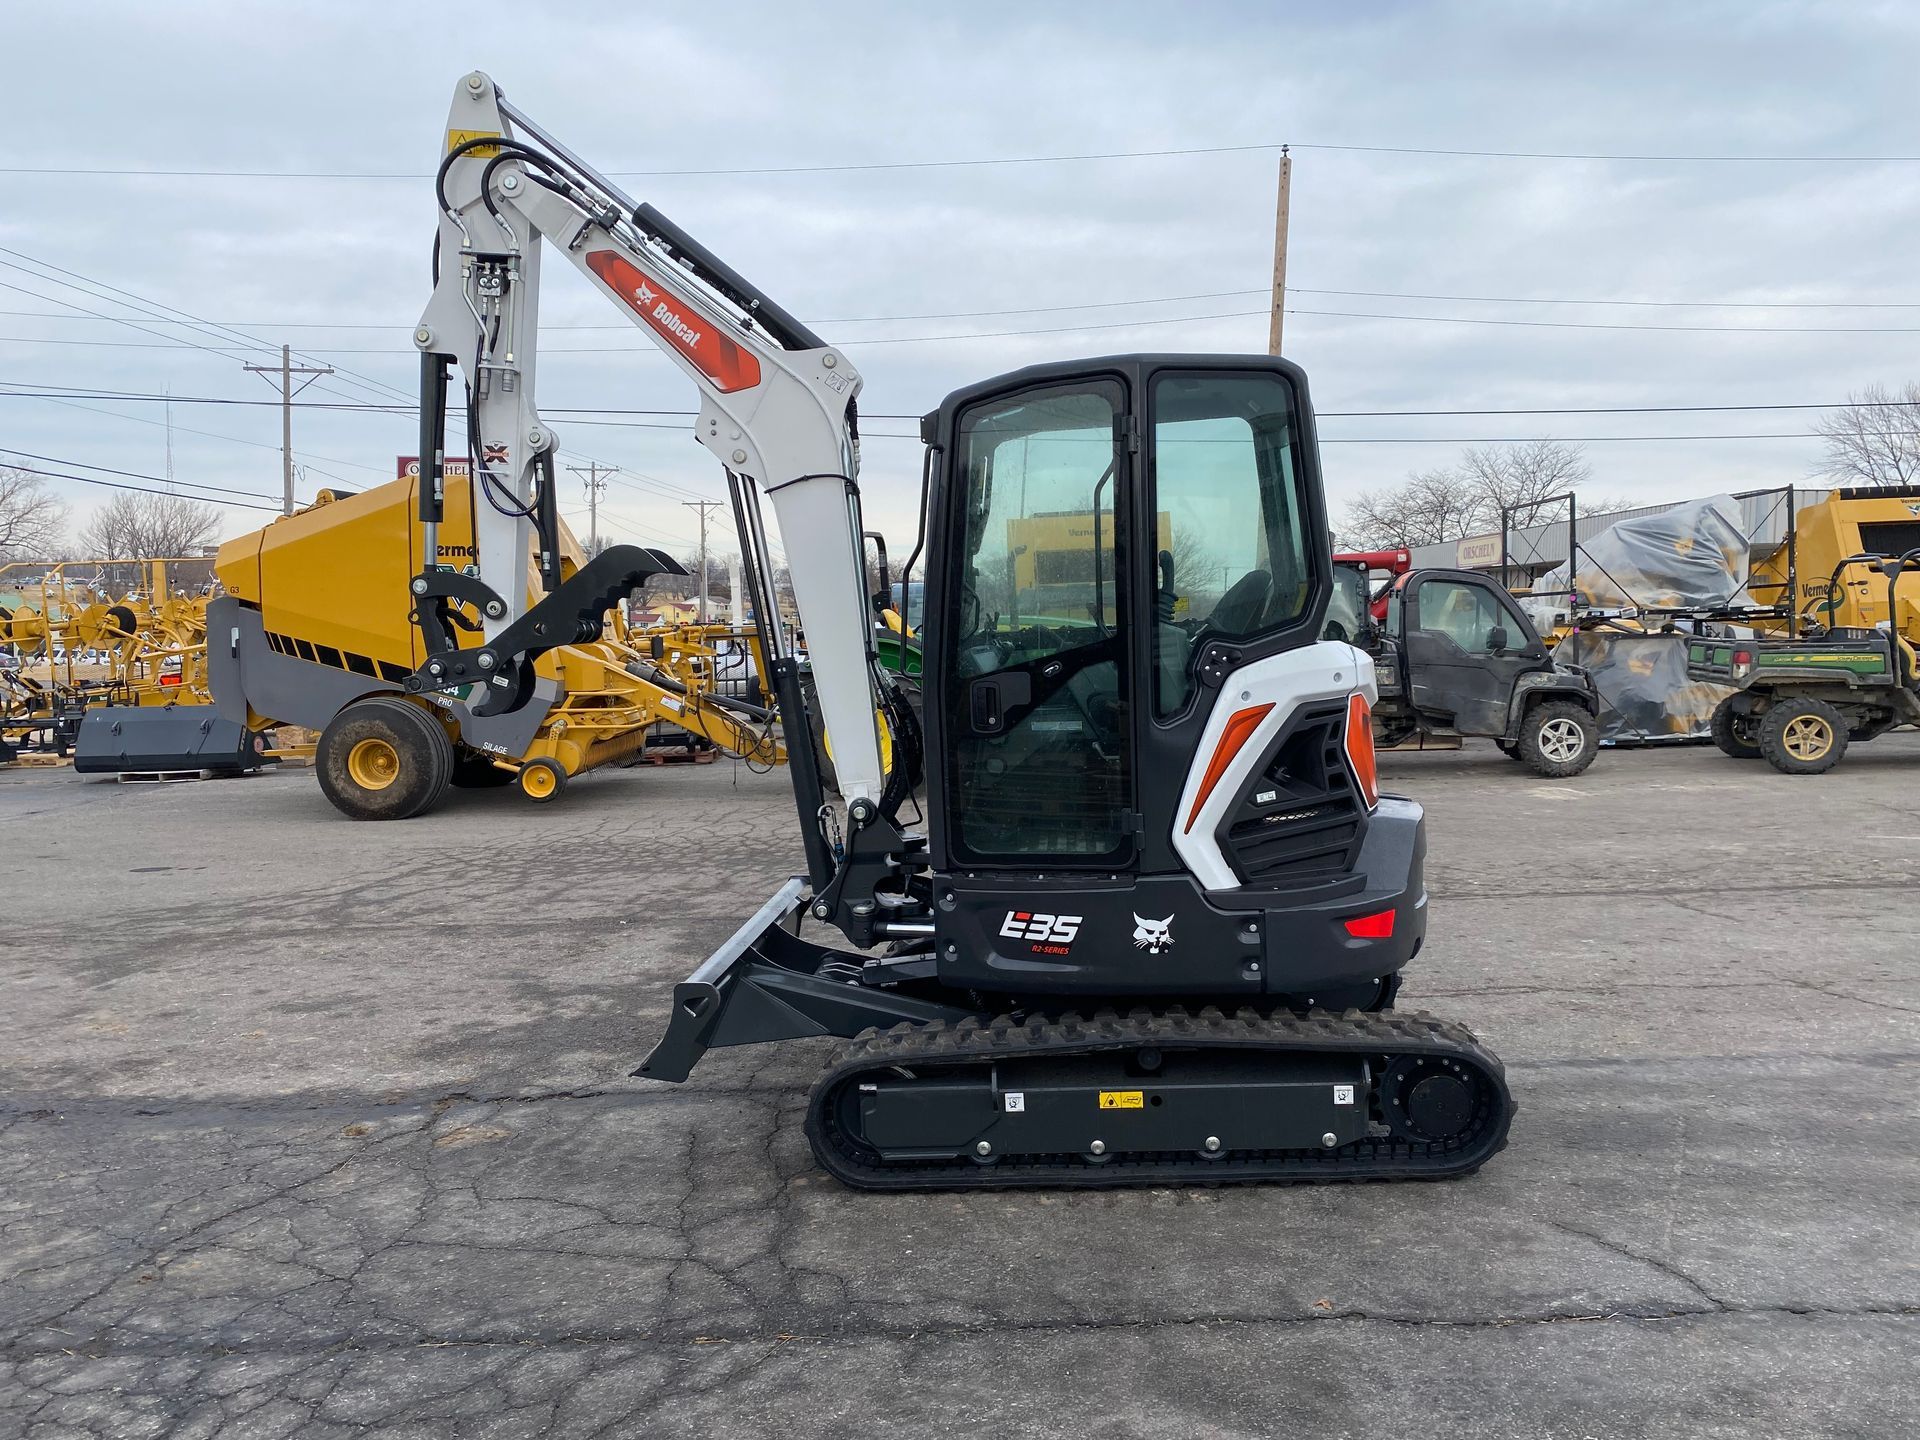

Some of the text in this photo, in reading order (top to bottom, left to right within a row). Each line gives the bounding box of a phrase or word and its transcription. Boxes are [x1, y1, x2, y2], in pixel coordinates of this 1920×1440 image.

[652, 301, 701, 347] Bobcat
[437, 696, 453, 707] PRO
[482, 741, 508, 755] SILAGE
[999, 911, 1084, 943] E35
[1031, 944, 1069, 955] R2-SERIES
